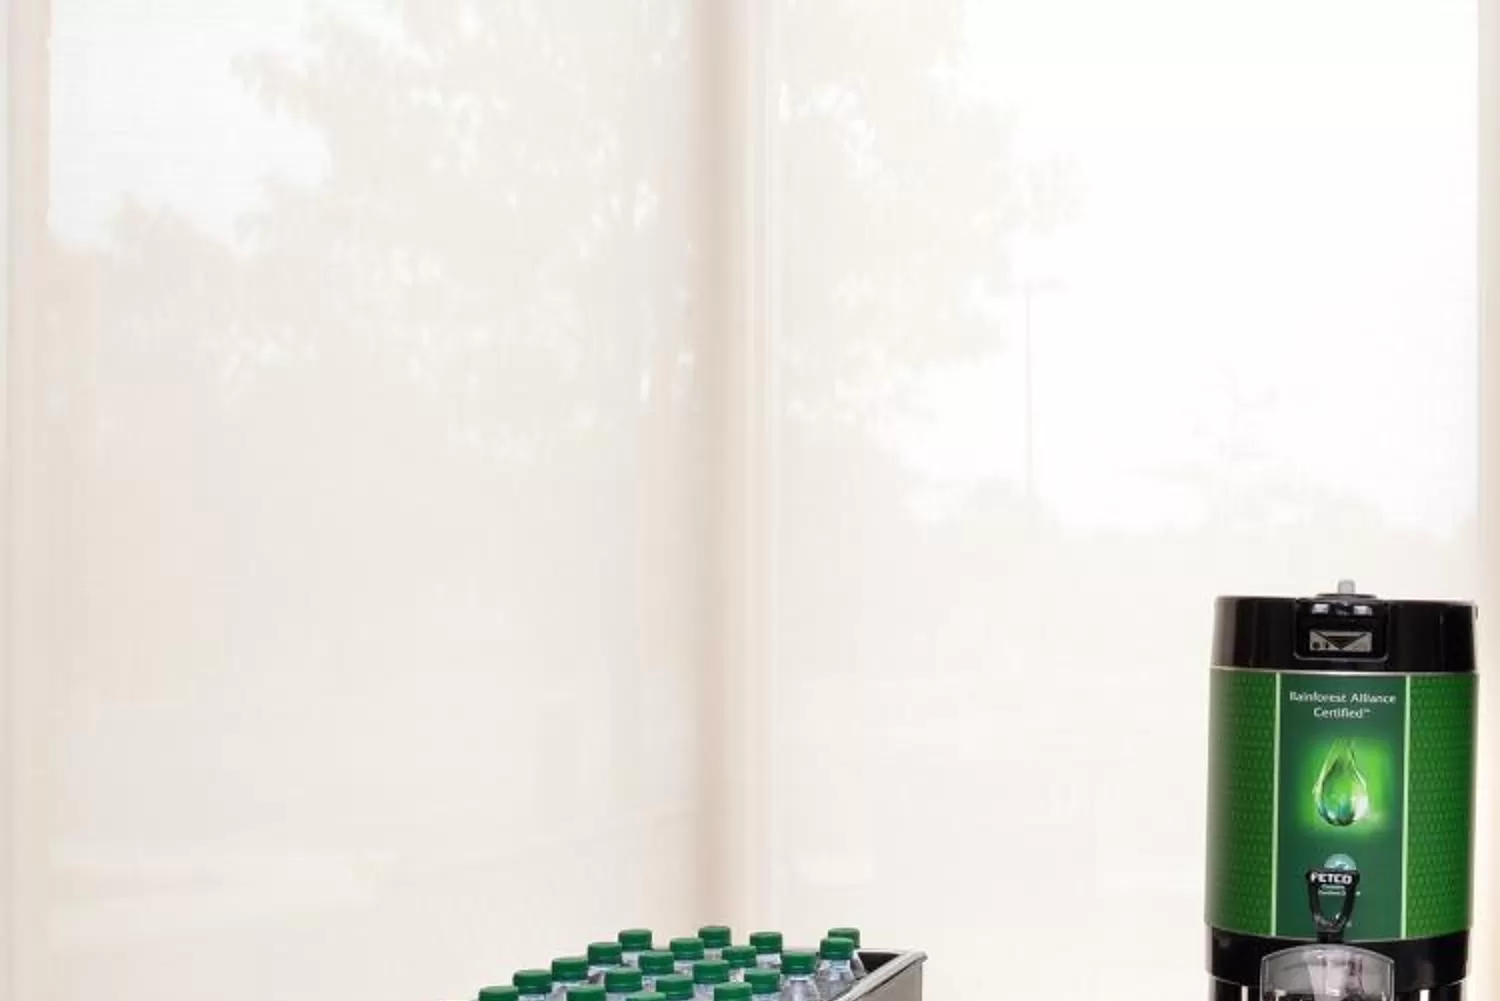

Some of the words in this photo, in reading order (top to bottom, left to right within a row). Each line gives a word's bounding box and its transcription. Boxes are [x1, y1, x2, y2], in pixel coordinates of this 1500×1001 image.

[1289, 691, 1346, 702] Rainforest
[1350, 692, 1396, 703] Alliance
[1310, 873, 1352, 884] FETCO
